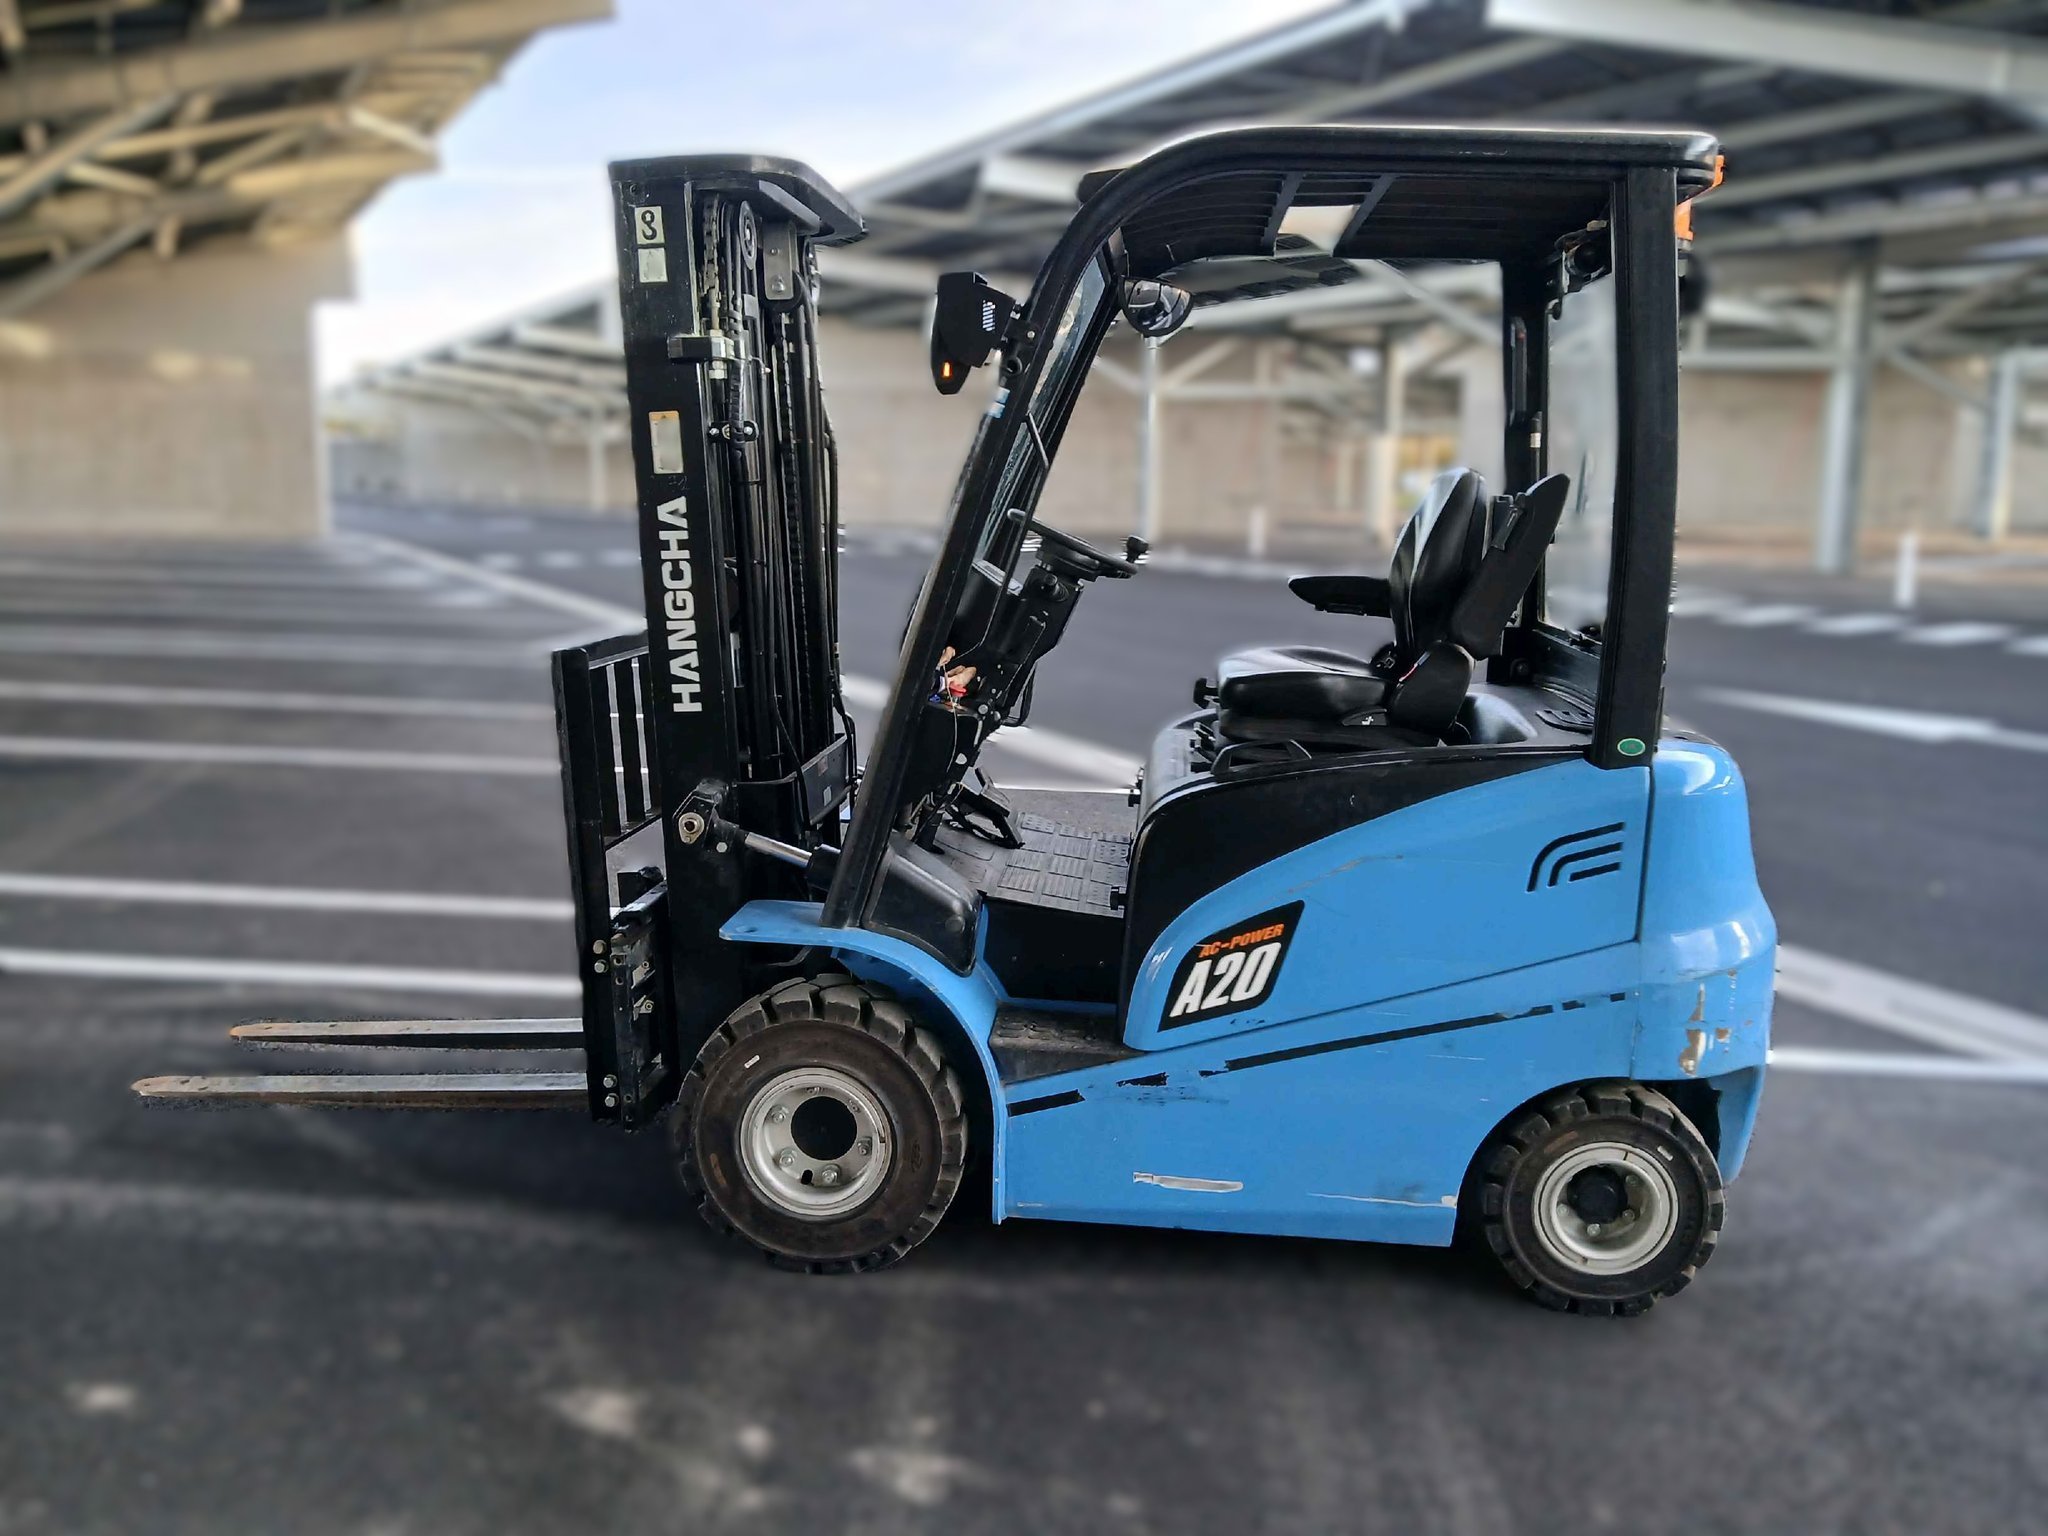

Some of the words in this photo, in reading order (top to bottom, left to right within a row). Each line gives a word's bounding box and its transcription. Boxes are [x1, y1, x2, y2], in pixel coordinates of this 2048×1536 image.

[657, 496, 702, 712] HANGCHA
[1198, 923, 1284, 958] AC-POWER
[1169, 942, 1281, 1018] A20
